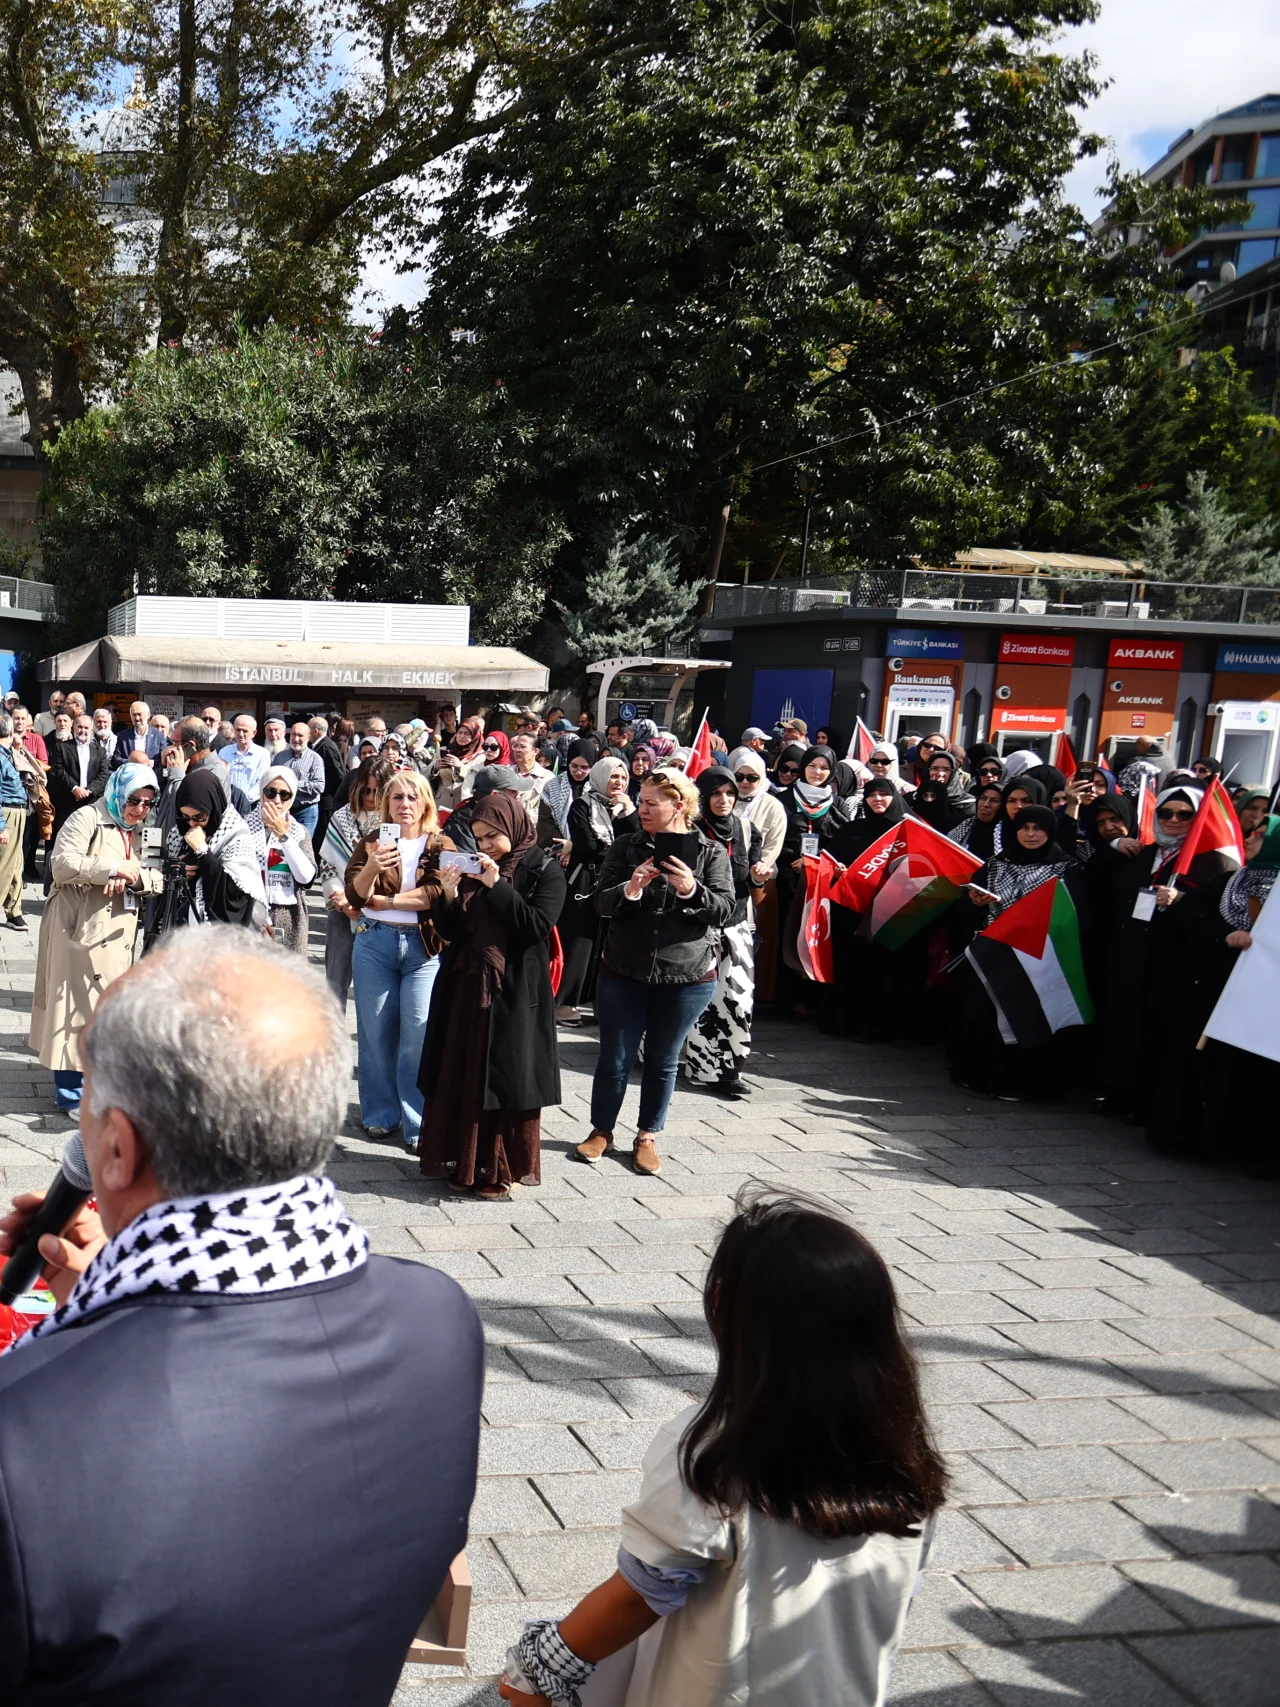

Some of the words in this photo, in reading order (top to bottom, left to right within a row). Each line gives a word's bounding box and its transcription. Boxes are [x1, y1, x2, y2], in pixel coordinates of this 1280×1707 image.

[892, 638, 921, 647] TÜRKİYE
[1011, 644, 1037, 654] Ziraat
[1037, 646, 1070, 657] Bankası
[1114, 649, 1175, 660] AKBANK
[224, 664, 303, 683] İSTANBUL
[331, 670, 374, 684] HALK
[402, 671, 456, 686] EKMEK
[894, 674, 952, 686] Bankamatik
[1117, 696, 1163, 705] AKBANK
[1028, 715, 1056, 723] Bankası
[858, 840, 907, 880] SAADET
